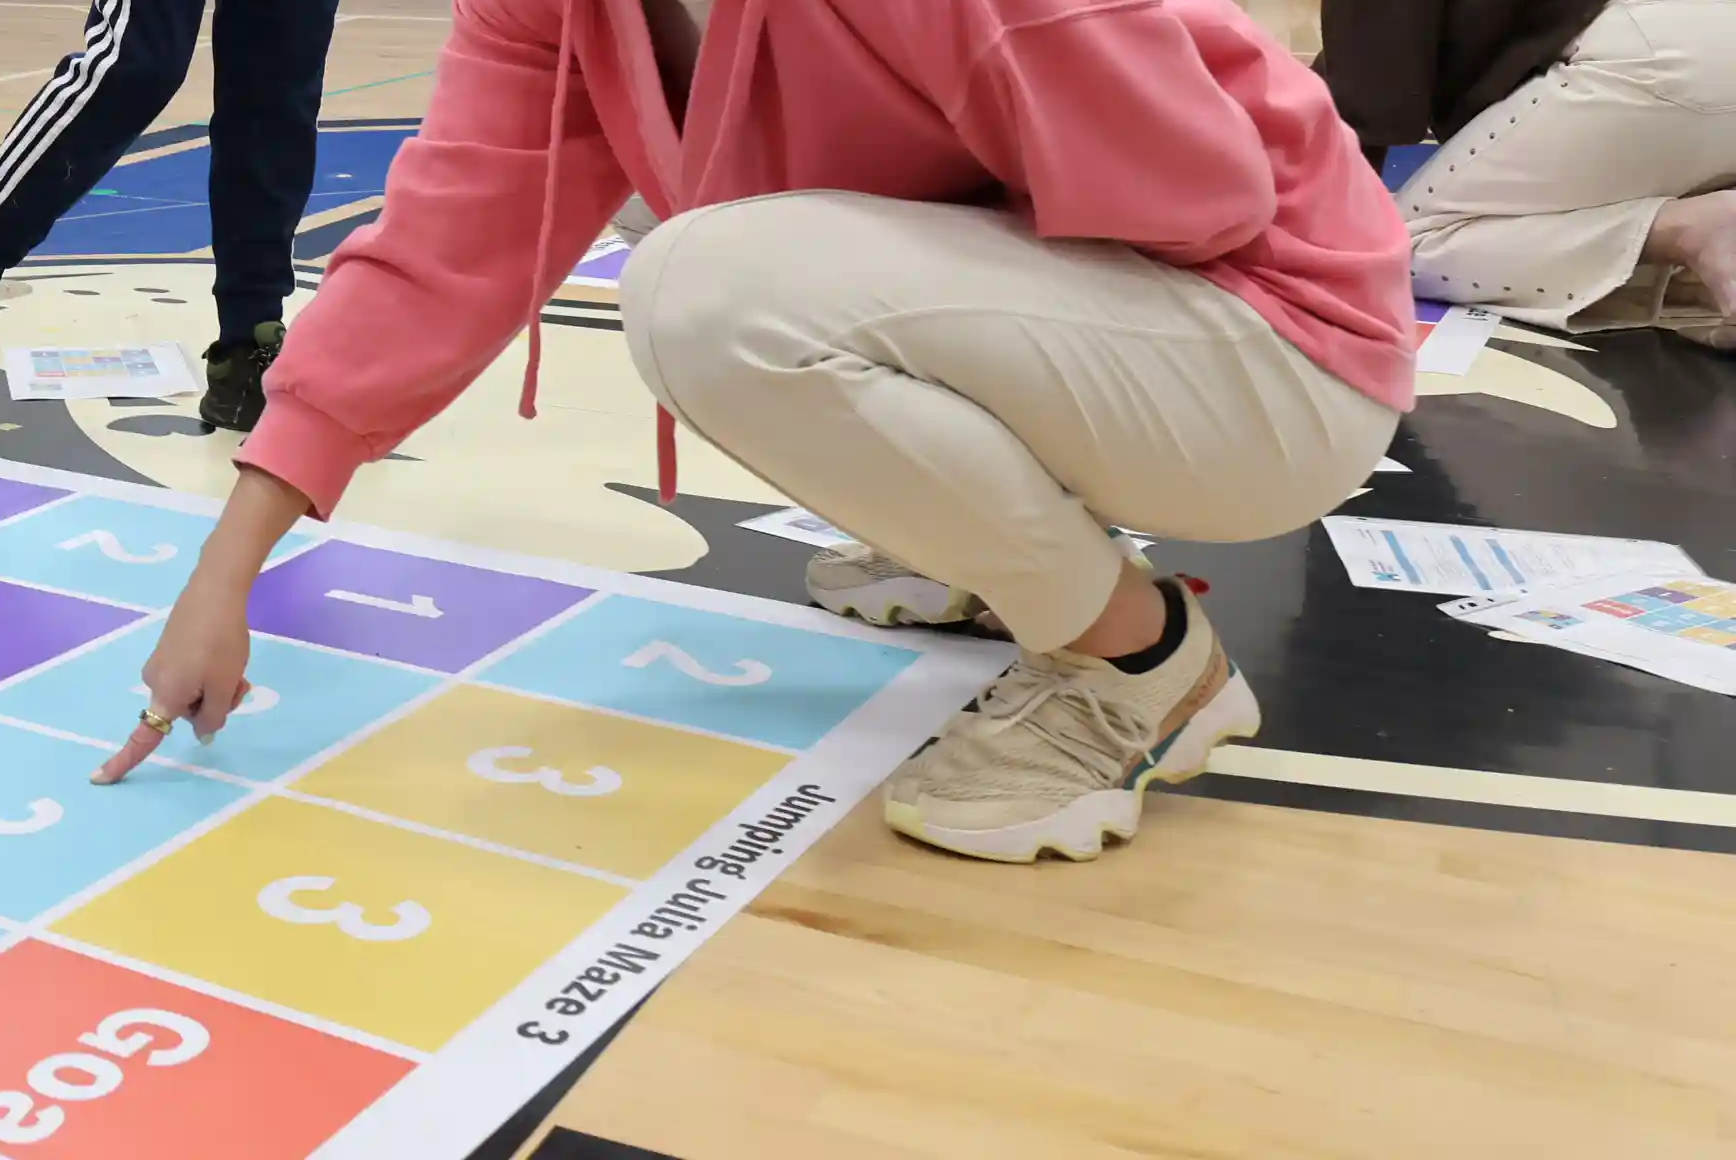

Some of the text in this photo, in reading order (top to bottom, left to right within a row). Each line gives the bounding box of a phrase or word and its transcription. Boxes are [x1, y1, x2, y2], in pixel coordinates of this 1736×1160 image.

[54, 529, 179, 564] 2
[325, 589, 444, 619] 1
[622, 640, 773, 686] 2
[467, 746, 623, 798] 3
[257, 875, 432, 942] 3
[517, 783, 837, 1045] Jumping Julia Maze 3
